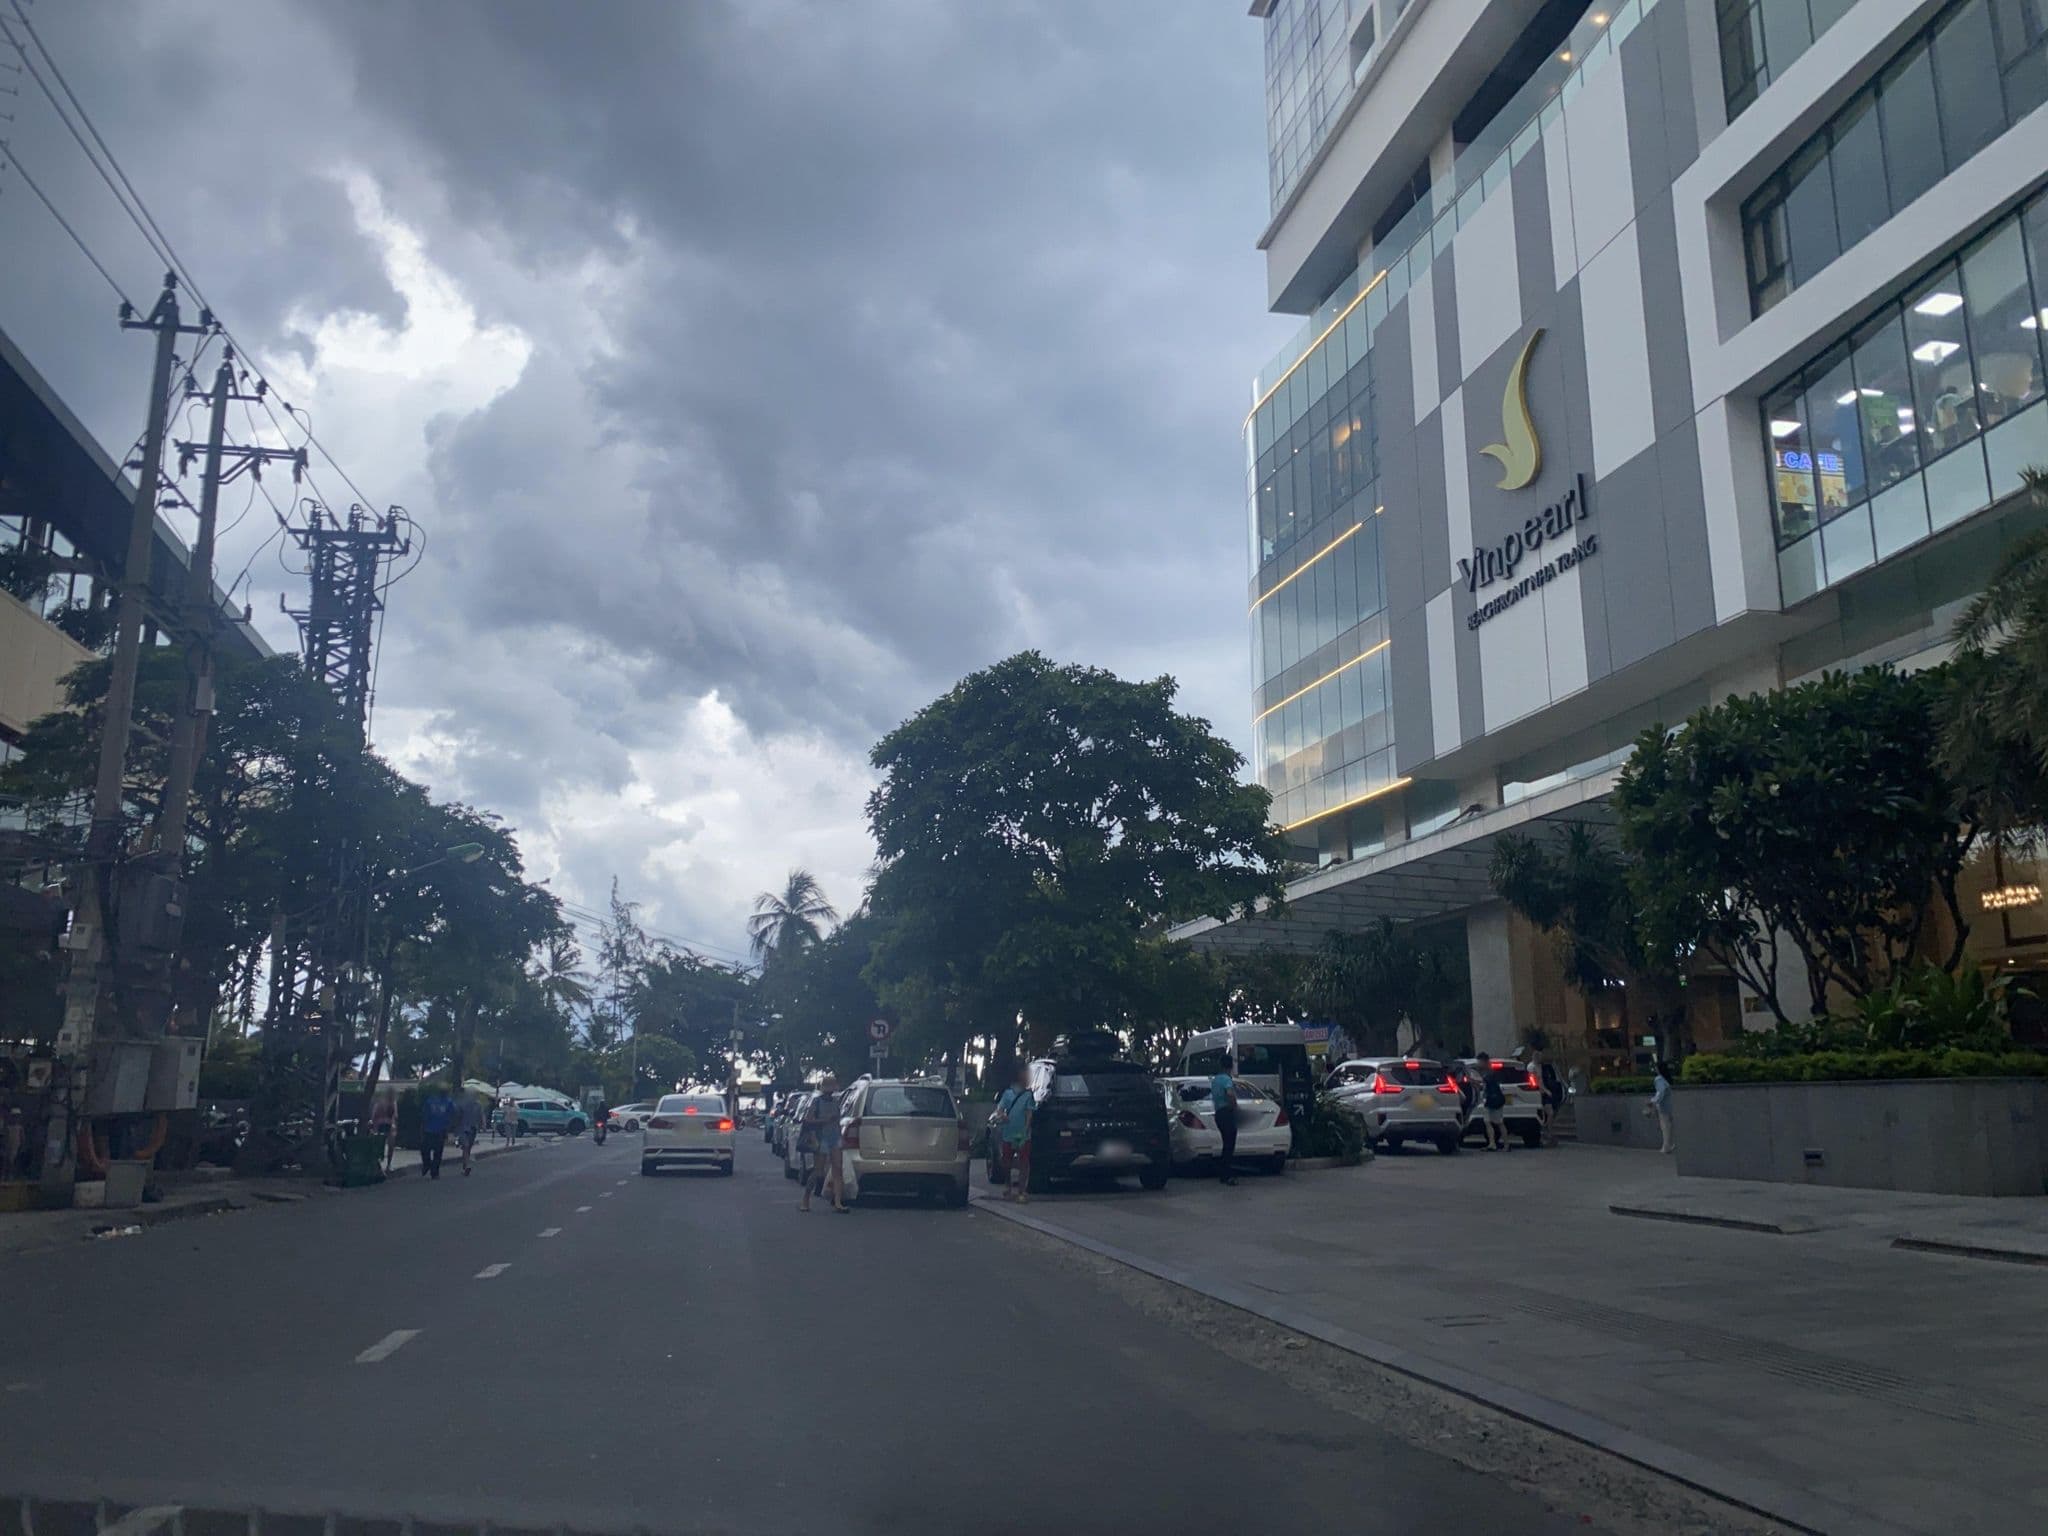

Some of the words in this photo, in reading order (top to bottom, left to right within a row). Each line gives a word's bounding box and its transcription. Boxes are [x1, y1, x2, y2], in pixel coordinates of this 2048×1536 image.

[1457, 473, 1589, 592] Vinpearl
[1530, 563, 1557, 591] NHA
[1556, 535, 1597, 573] TRANG
